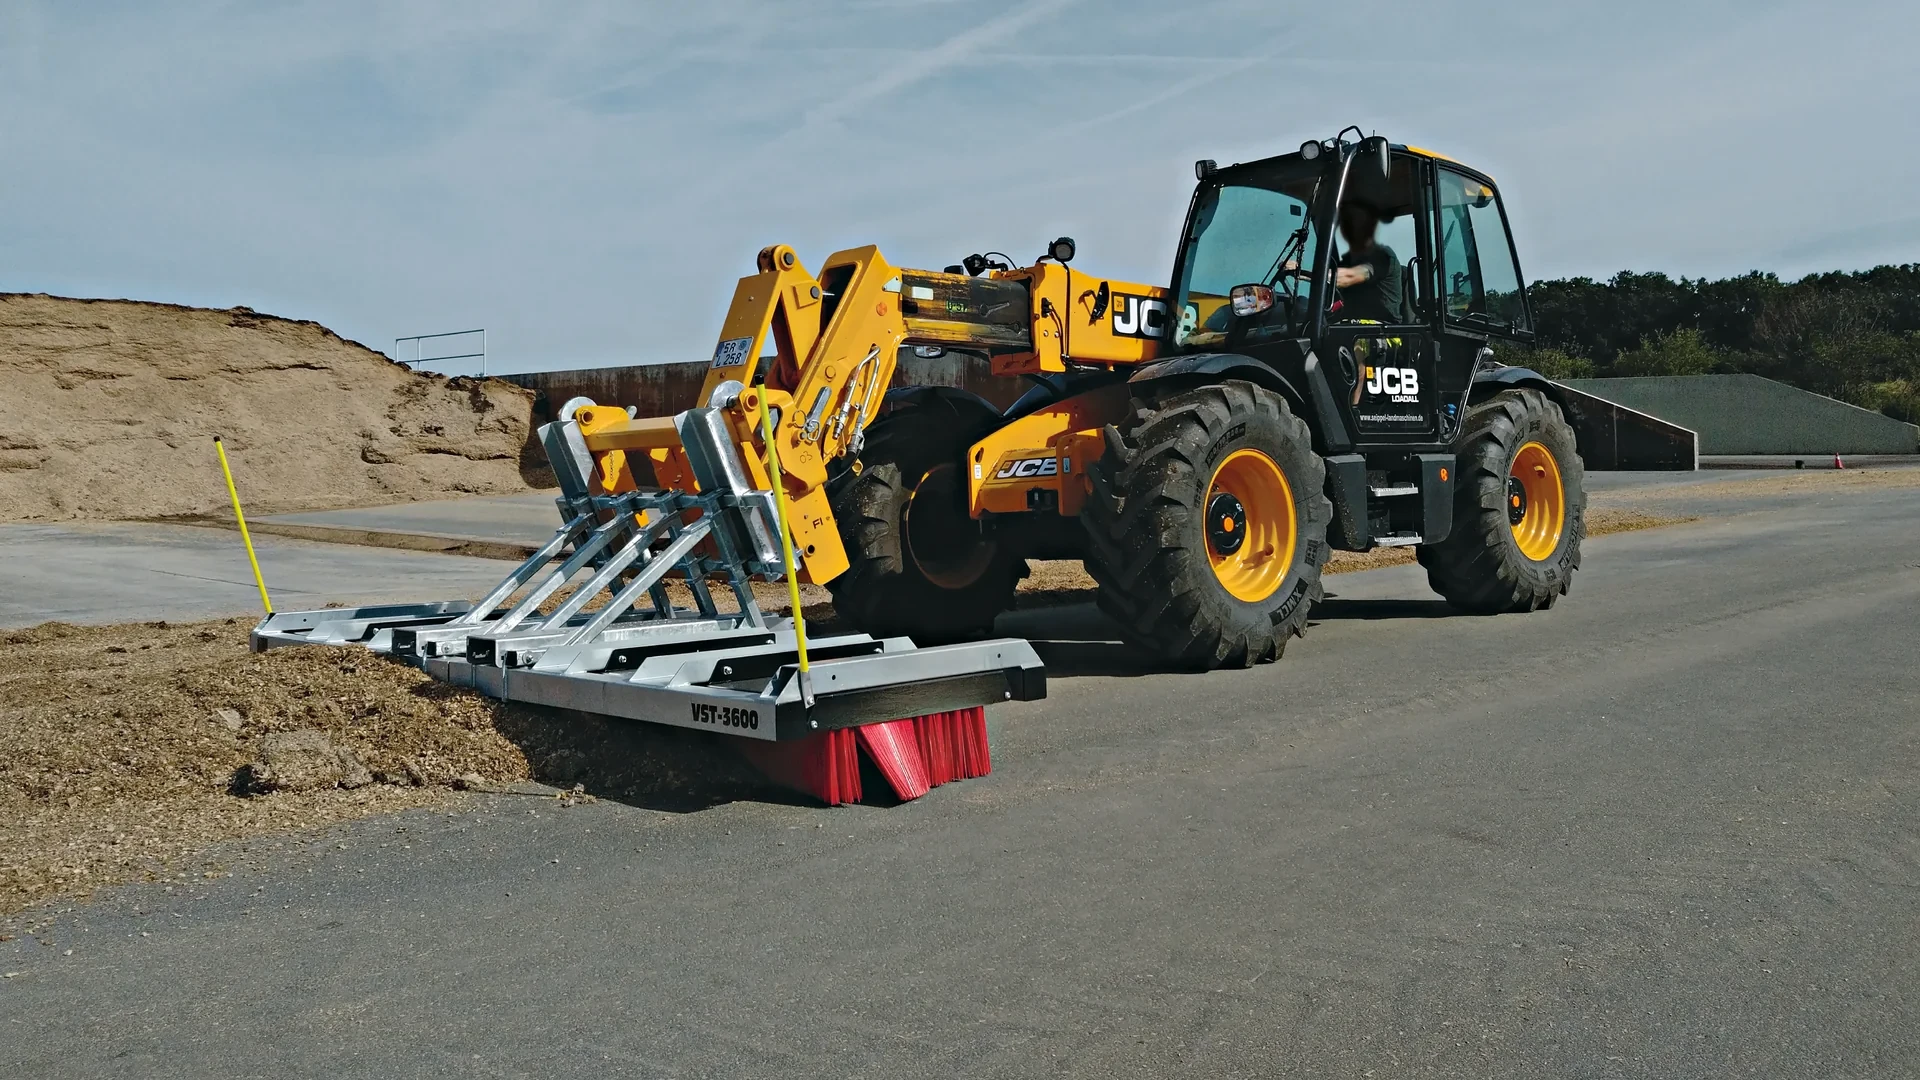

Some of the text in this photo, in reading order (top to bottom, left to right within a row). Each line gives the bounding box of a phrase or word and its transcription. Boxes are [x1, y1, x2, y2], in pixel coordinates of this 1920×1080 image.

[1114, 297, 1197, 347] JCB
[723, 352, 742, 366] 258
[1366, 367, 1419, 395] JCB
[1391, 395, 1419, 403] LOADALL
[997, 458, 1057, 479] JCB
[1276, 587, 1303, 620] XMCL
[691, 702, 759, 730] VST-3600
